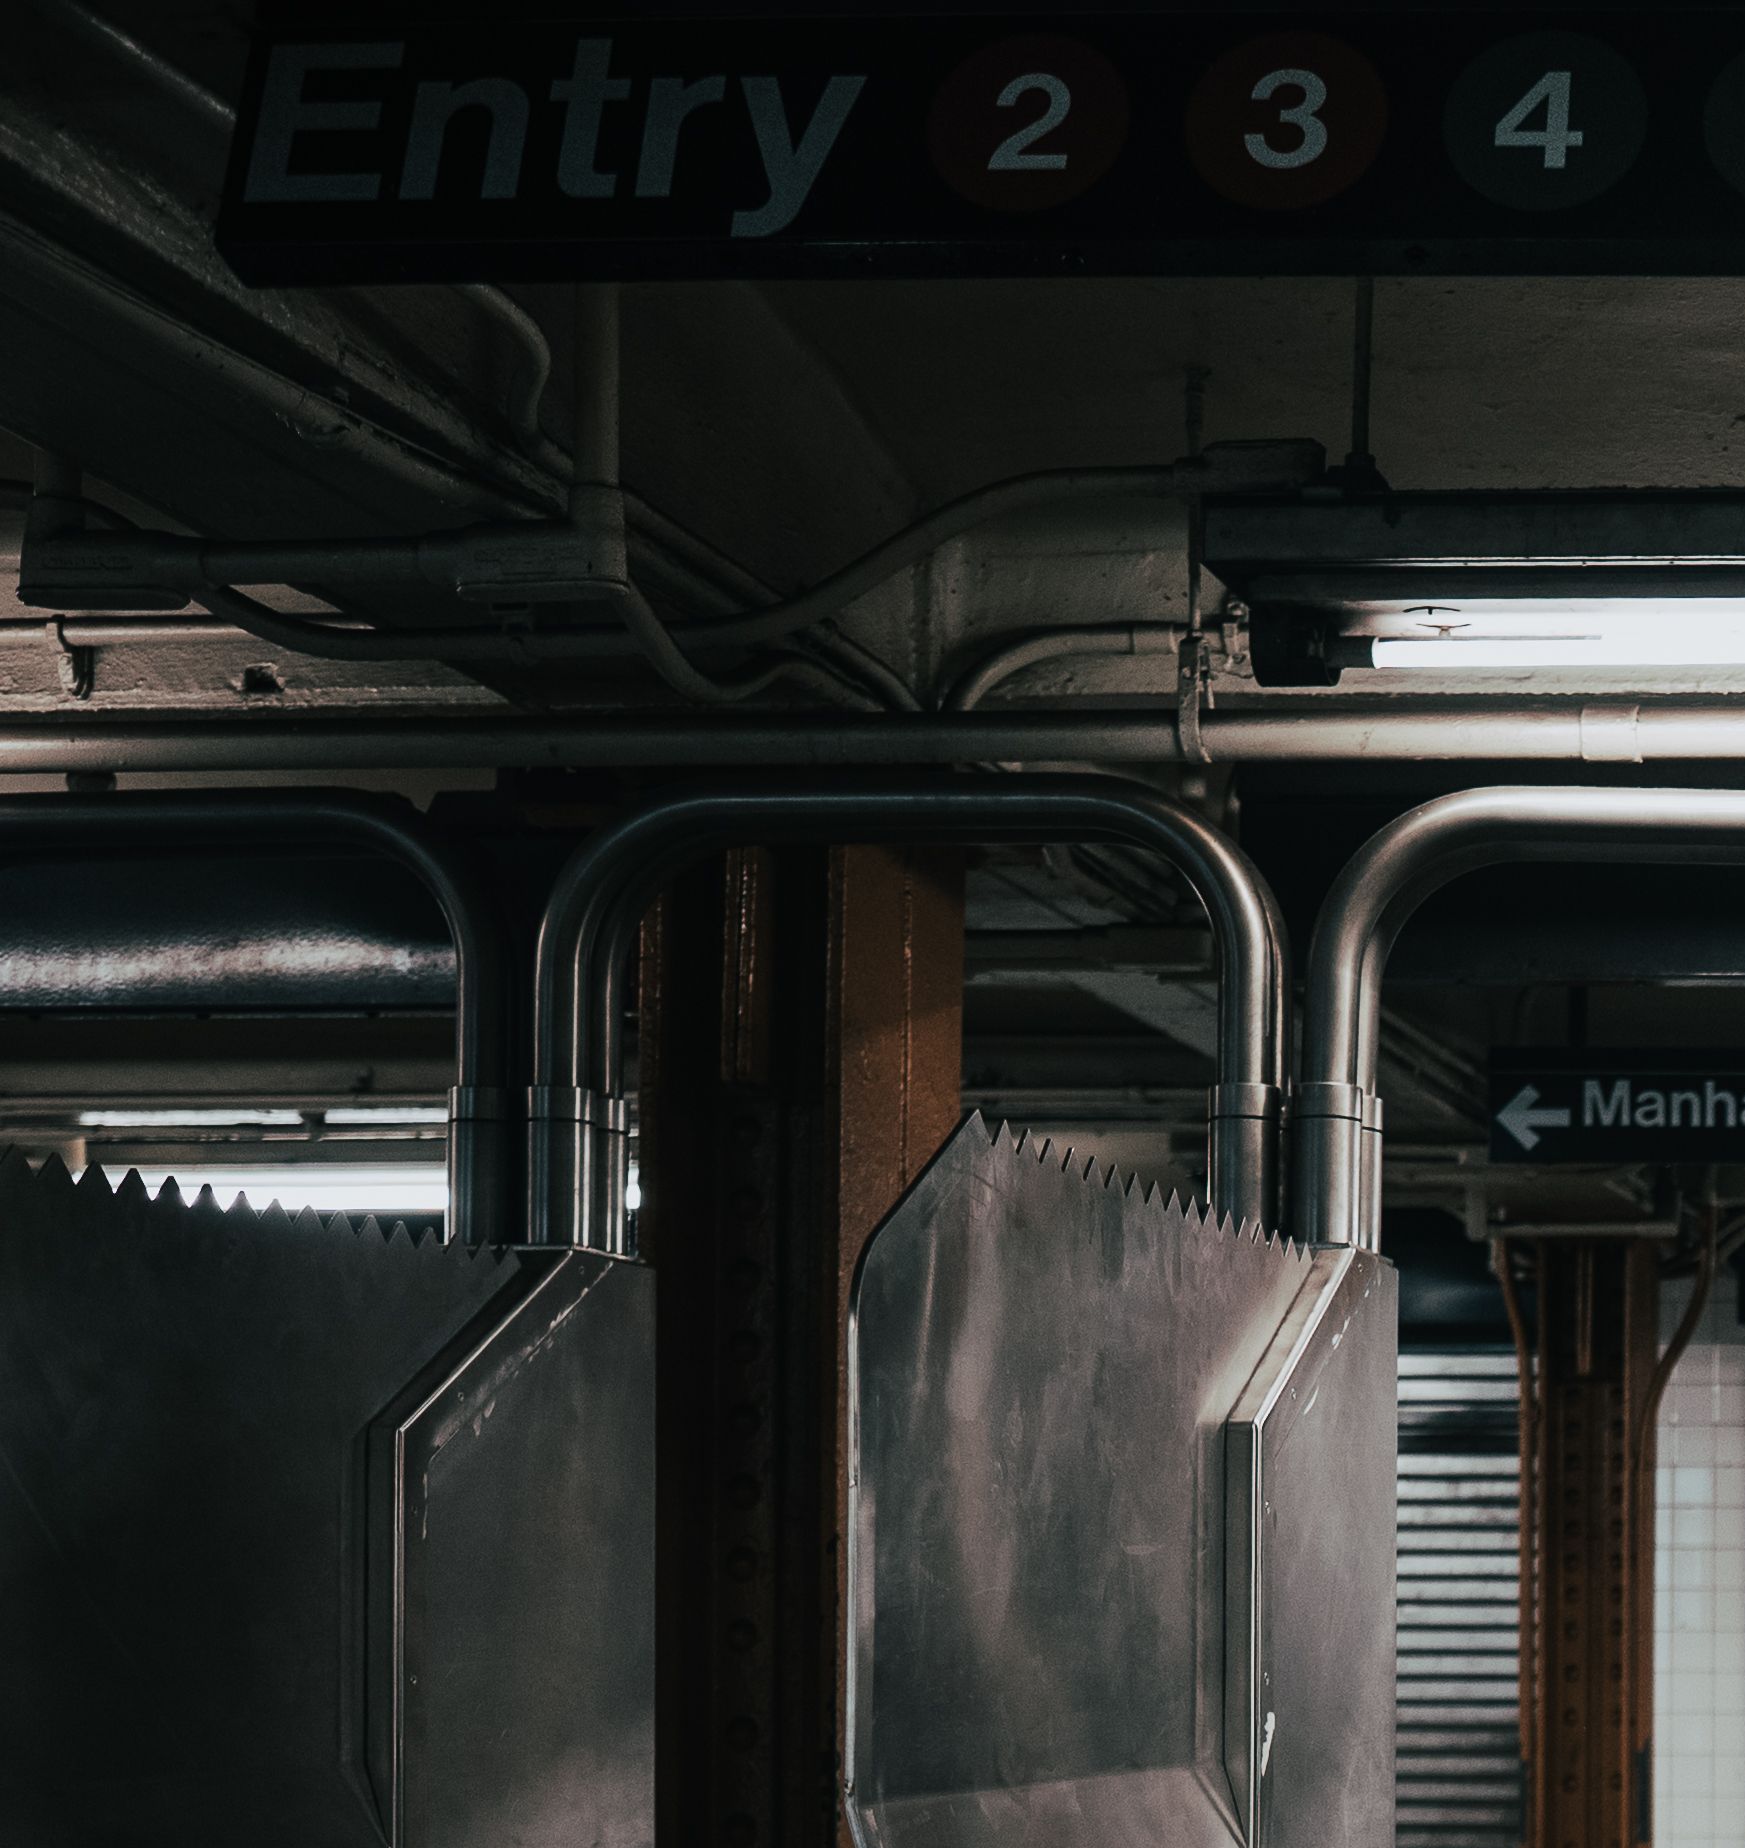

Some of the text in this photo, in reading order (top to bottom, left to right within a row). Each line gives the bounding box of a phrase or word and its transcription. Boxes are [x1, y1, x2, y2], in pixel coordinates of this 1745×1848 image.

[243, 36, 866, 238] Entry
[987, 71, 1073, 171] 2
[1243, 67, 1330, 171] 3
[1493, 70, 1585, 170] 4
